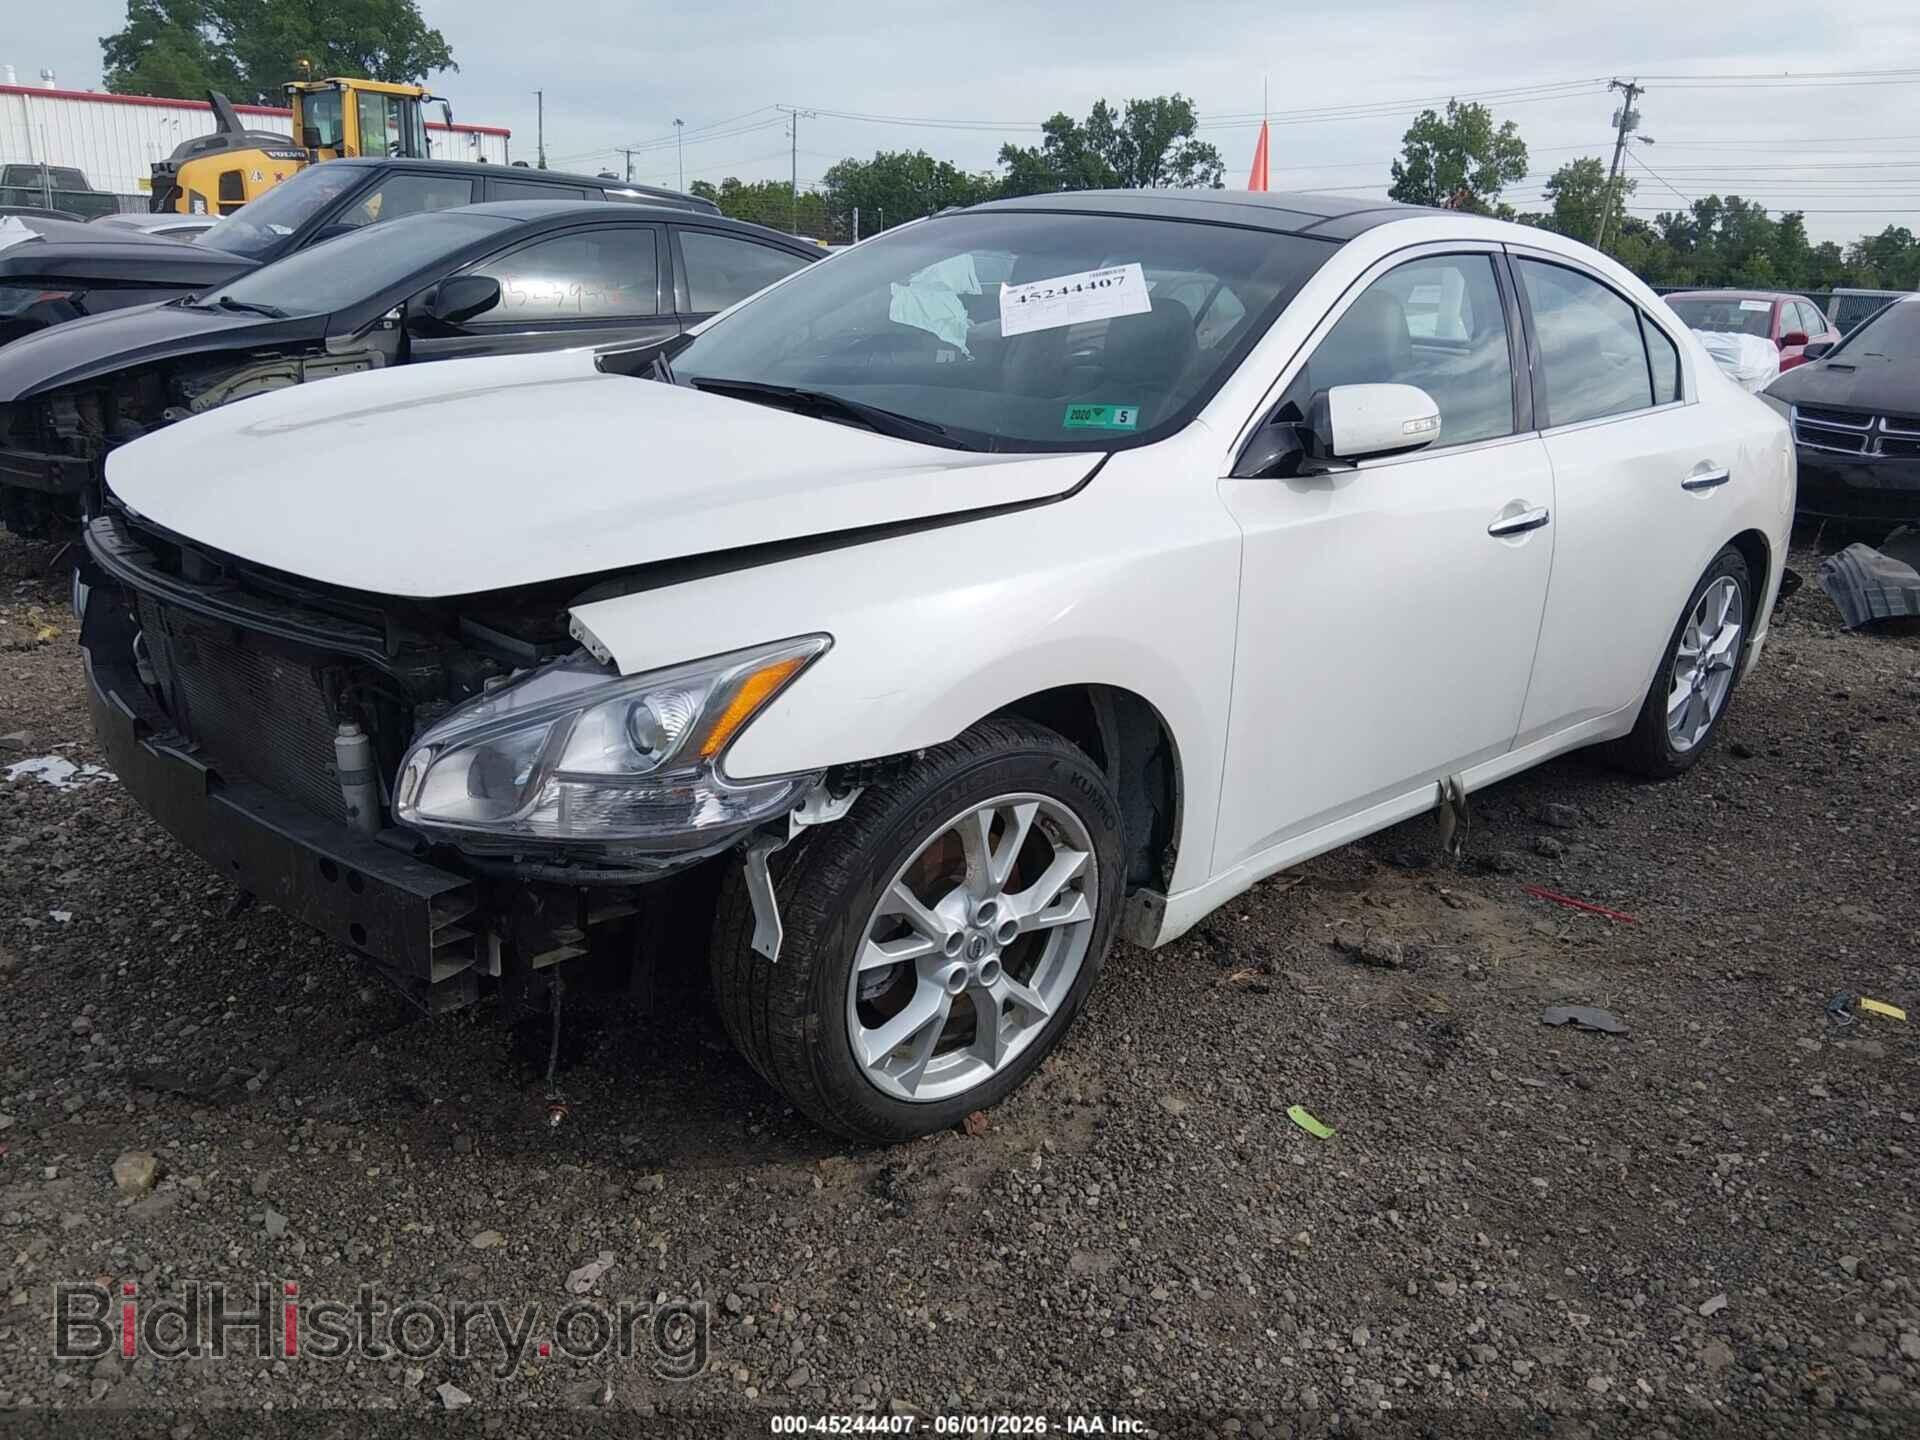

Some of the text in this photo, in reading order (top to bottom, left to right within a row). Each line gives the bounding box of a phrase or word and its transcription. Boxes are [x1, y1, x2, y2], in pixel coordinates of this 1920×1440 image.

[1015, 275, 1127, 304] 45244407
[1119, 410, 1129, 423] 5
[1069, 771, 1117, 831] KUMHO
